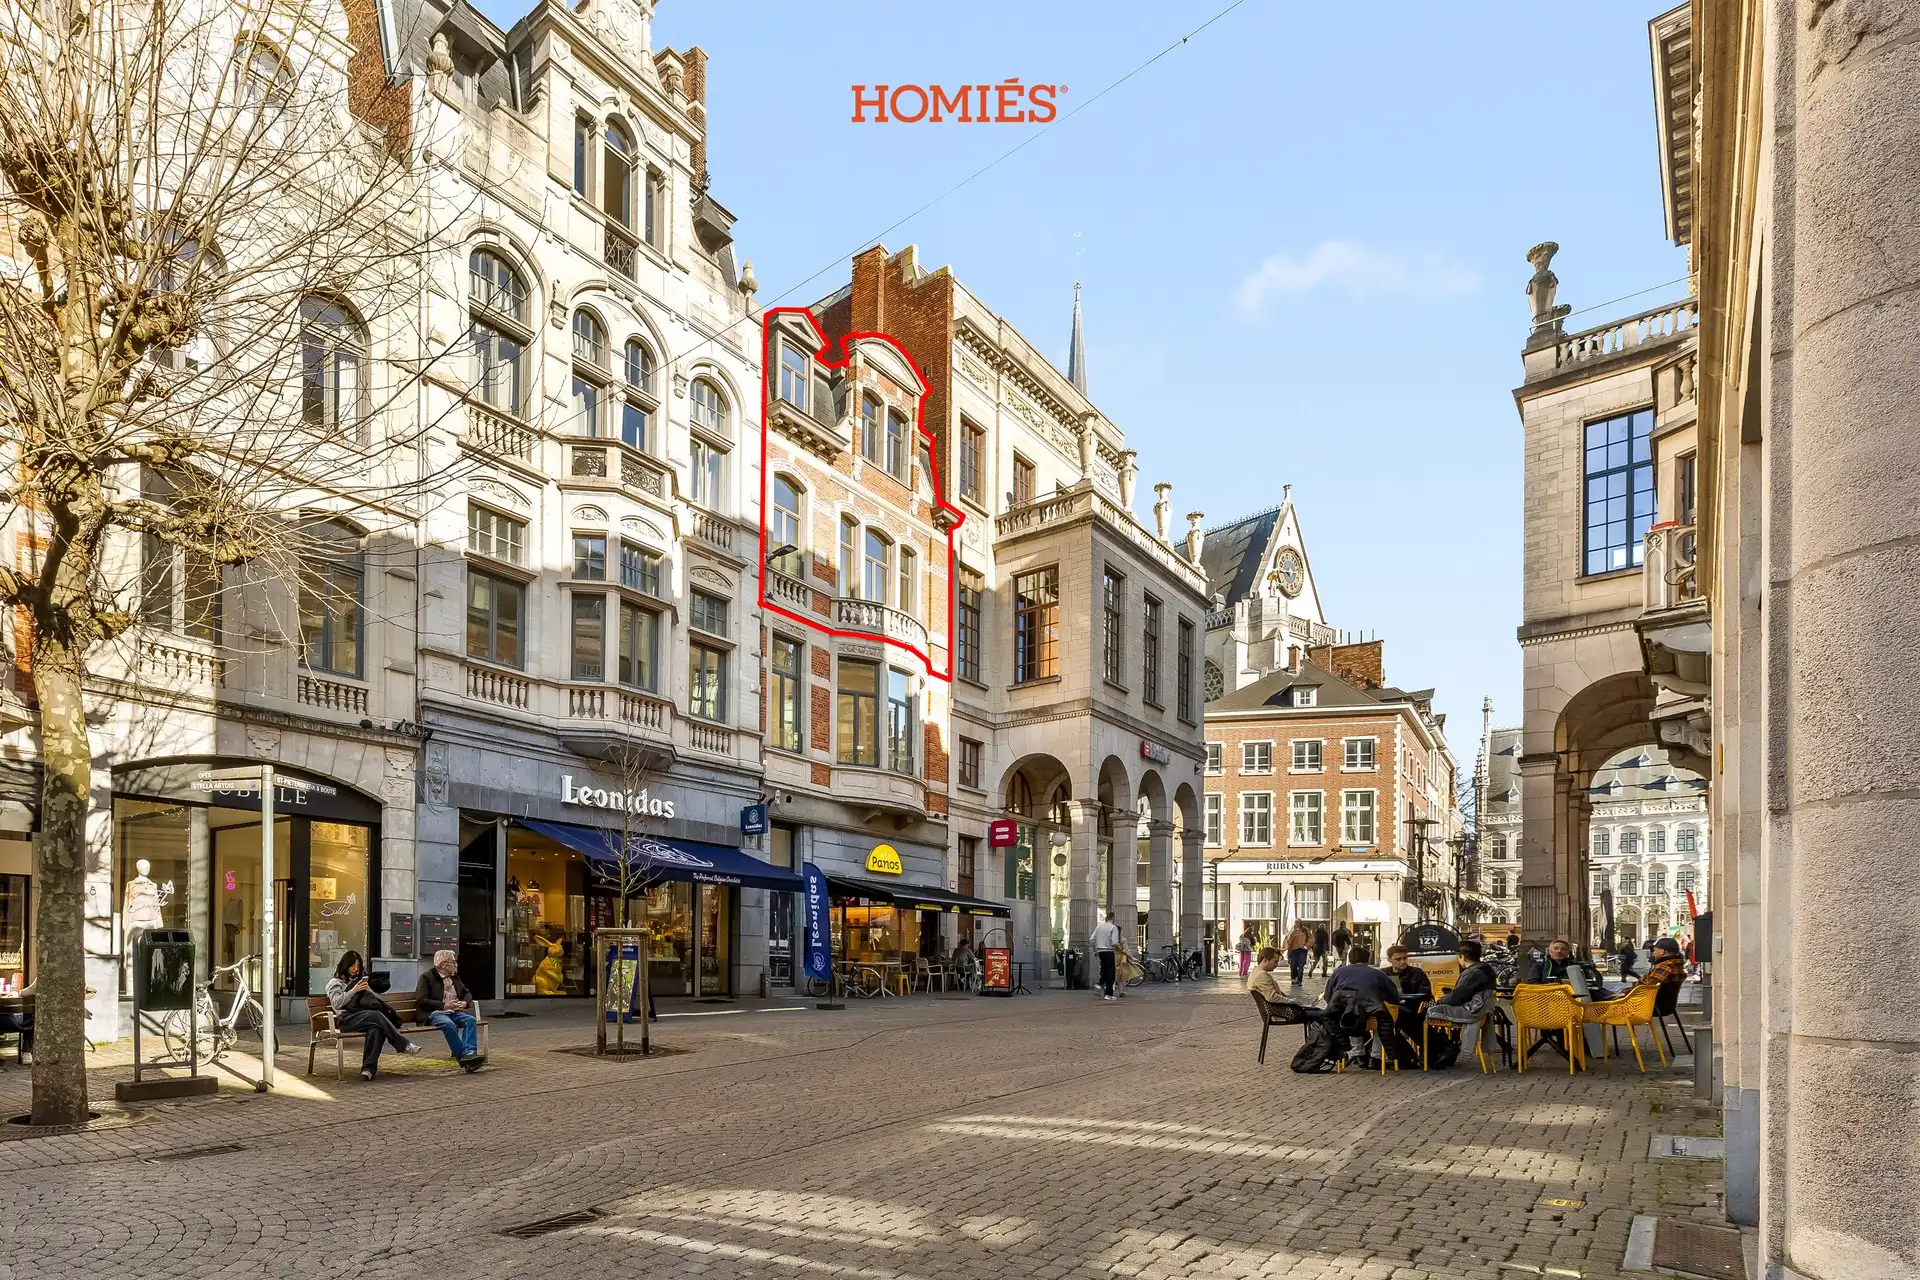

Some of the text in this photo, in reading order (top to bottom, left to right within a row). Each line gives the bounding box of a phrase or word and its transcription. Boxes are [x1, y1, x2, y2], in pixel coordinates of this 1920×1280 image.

[192, 781, 213, 790] STELLA
[560, 774, 675, 819] Leonidas
[872, 856, 900, 870] Panos
[1266, 862, 1305, 870] RUBENS
[89, 885, 97, 896] 8
[446, 902, 453, 911] 6
